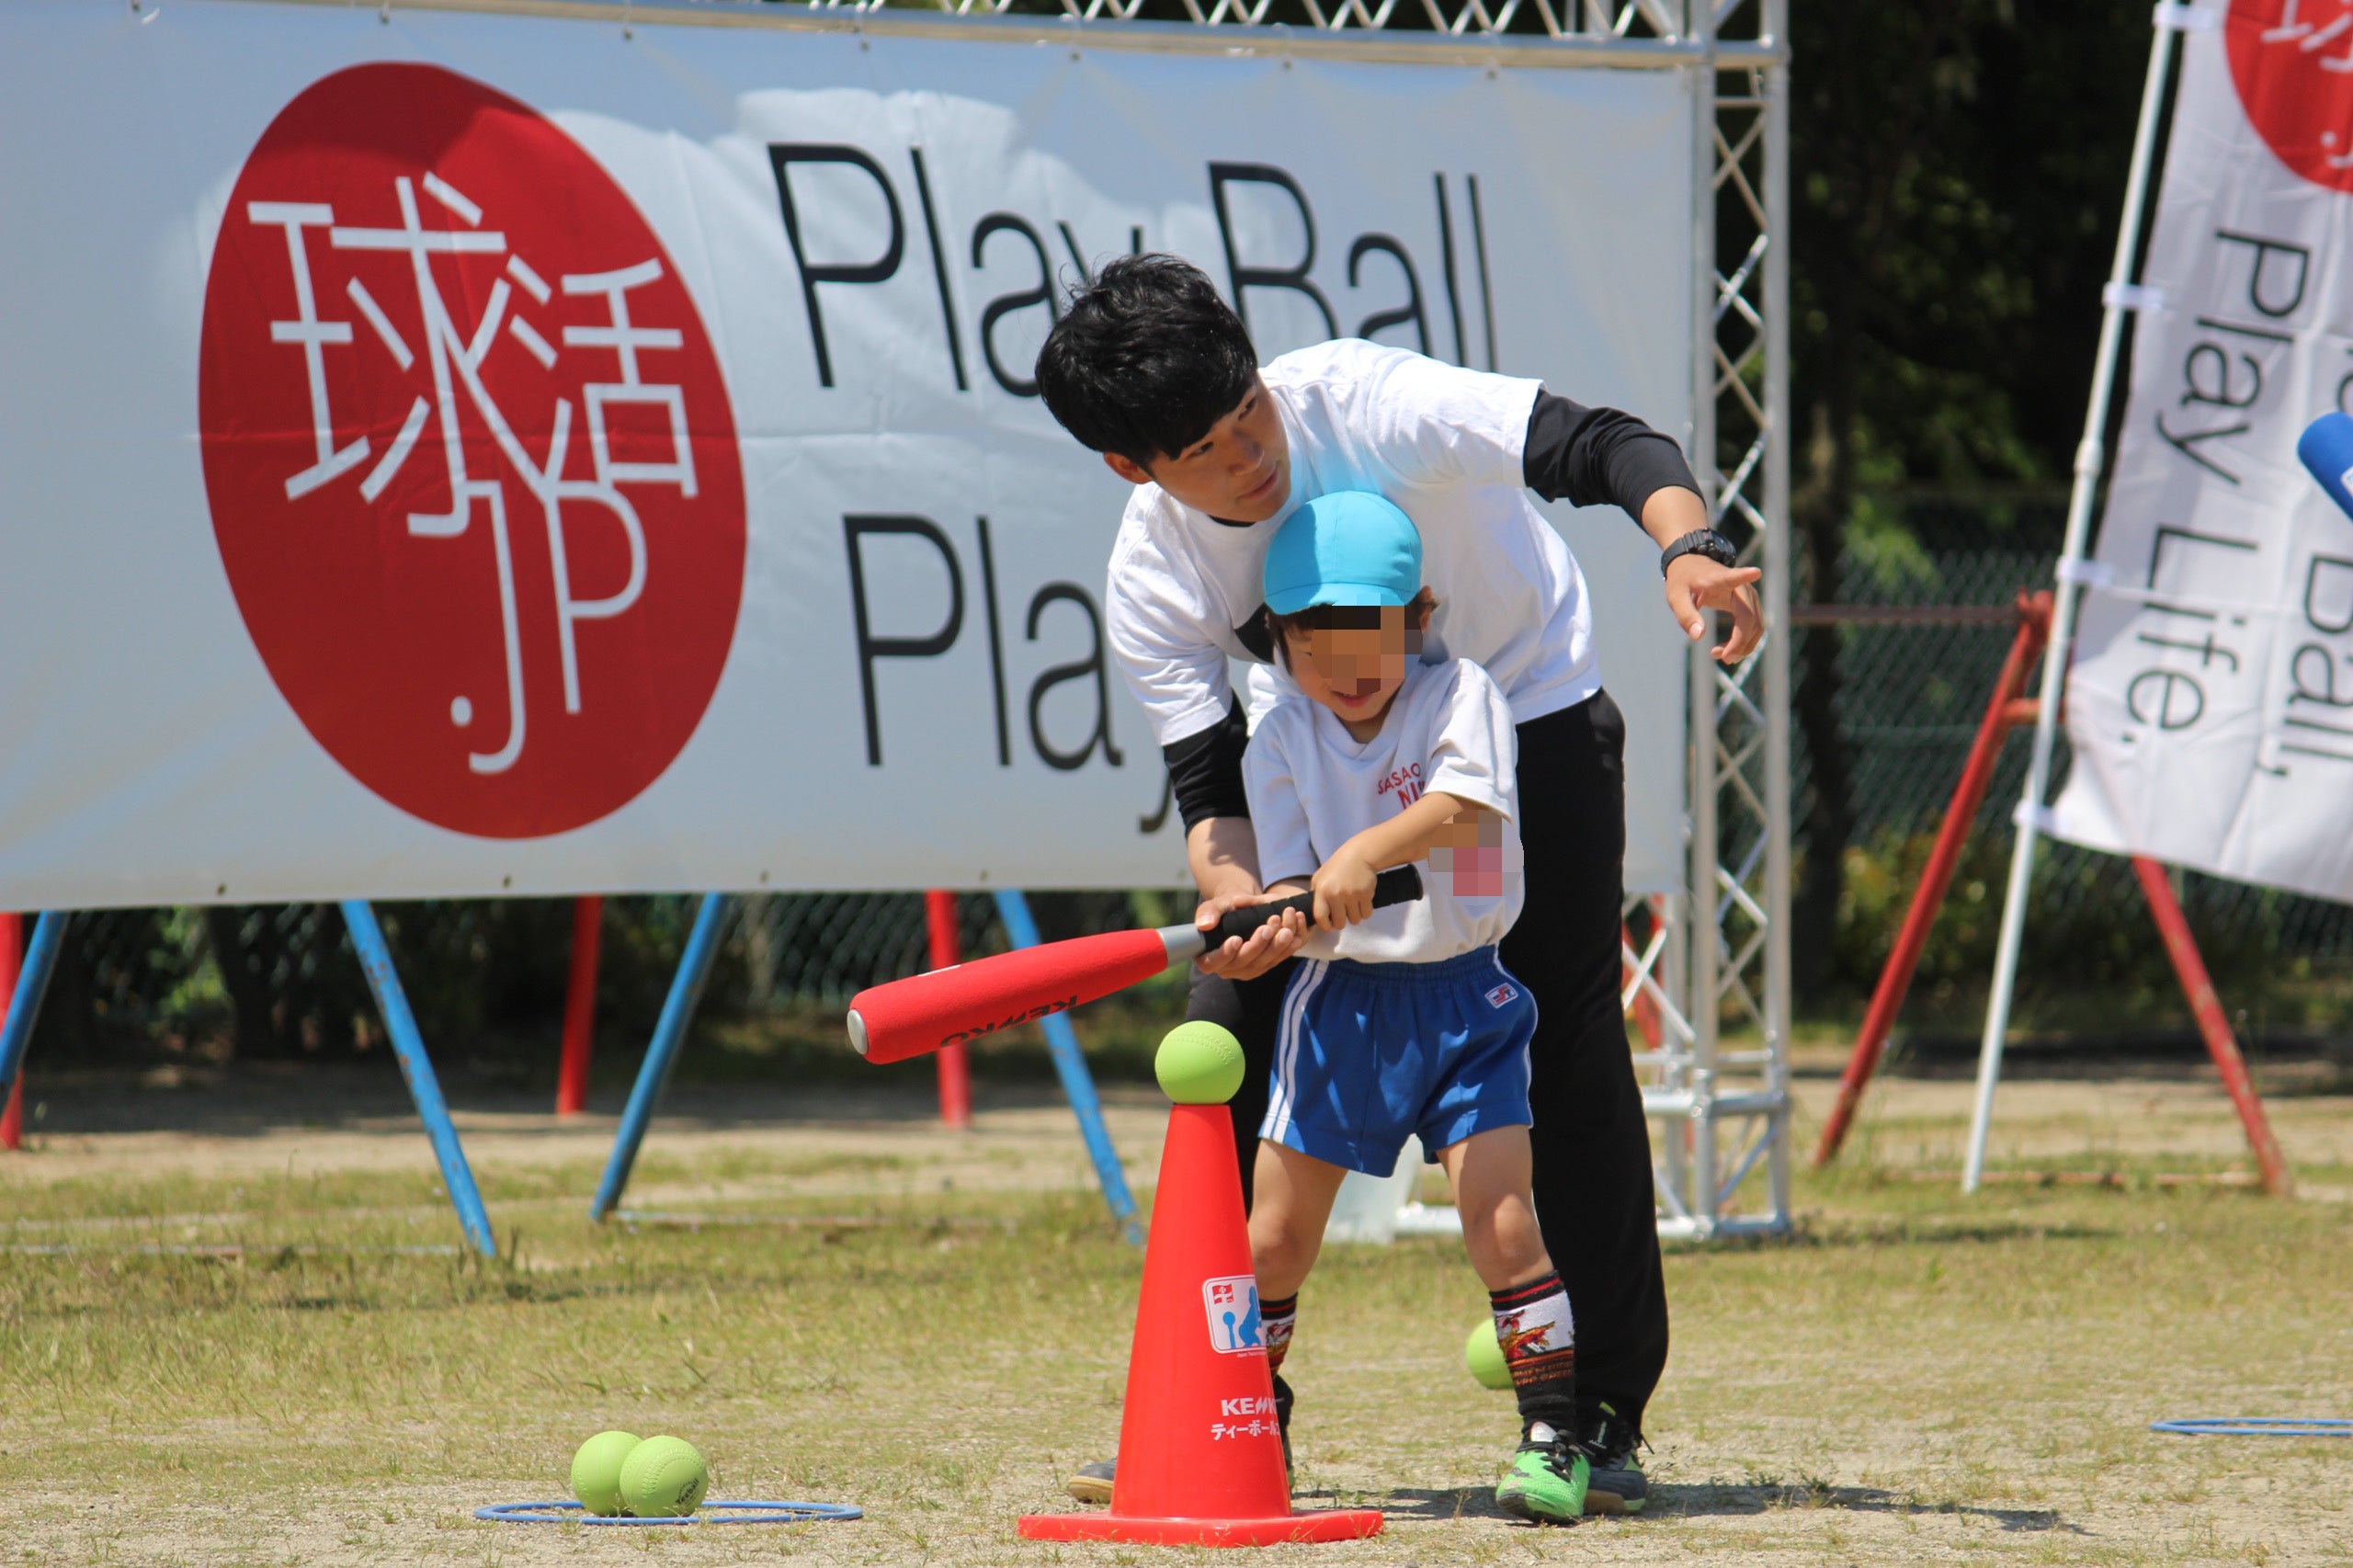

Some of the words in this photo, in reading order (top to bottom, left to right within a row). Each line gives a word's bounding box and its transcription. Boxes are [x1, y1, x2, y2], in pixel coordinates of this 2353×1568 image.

[2155, 227, 2310, 485] Play
[842, 514, 1171, 834] Pla
[2121, 522, 2259, 744] Life,
